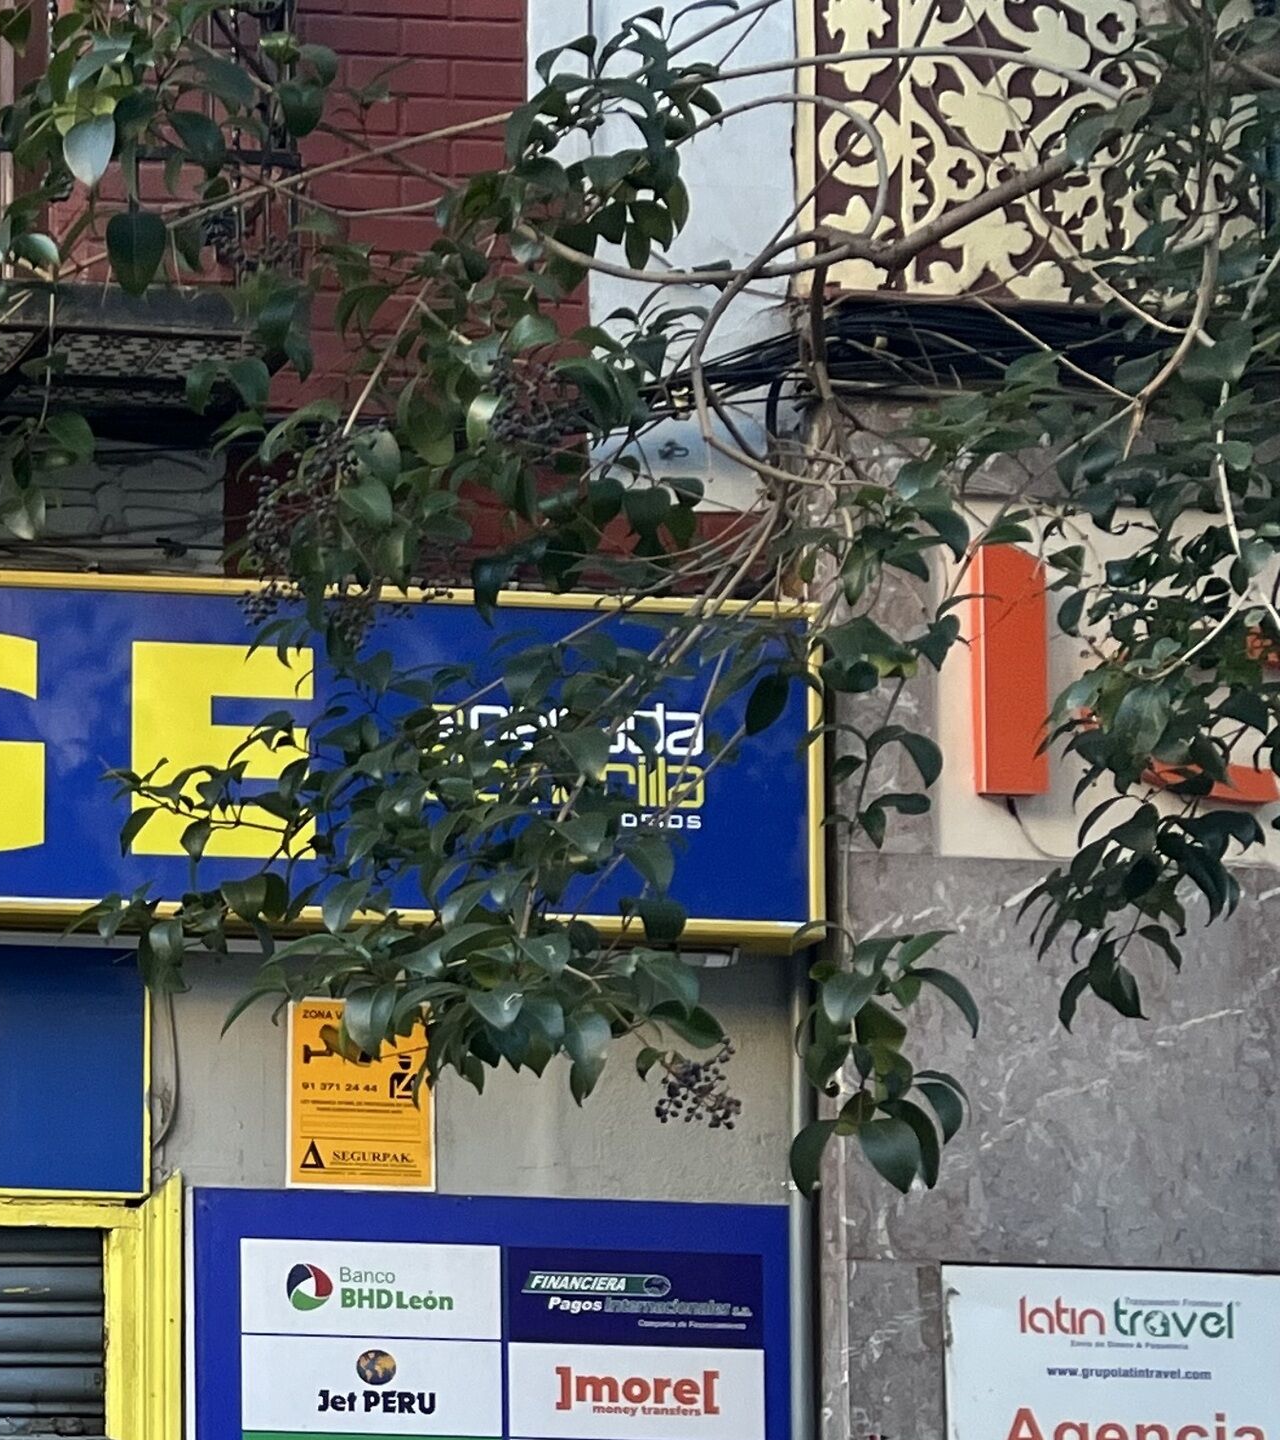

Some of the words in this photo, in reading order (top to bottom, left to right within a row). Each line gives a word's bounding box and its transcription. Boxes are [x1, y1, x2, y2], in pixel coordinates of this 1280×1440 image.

[302, 1009, 332, 1019] ZONA
[301, 1081, 316, 1091] 91
[319, 1082, 341, 1091] 371
[345, 1083, 360, 1092] 24
[362, 1084, 378, 1093] 44
[339, 1266, 396, 1284] Banco
[531, 1275, 626, 1292] FINANCIERA
[548, 1297, 603, 1314] Pagos
[1019, 1296, 1106, 1336] latin
[1114, 1297, 1234, 1340] travel
[1047, 1366, 1212, 1380] www.grupolatintravel.com
[318, 1390, 356, 1412] Jet
[363, 1391, 436, 1414] PERU
[592, 1405, 637, 1417] money
[641, 1405, 702, 1416] transfers
